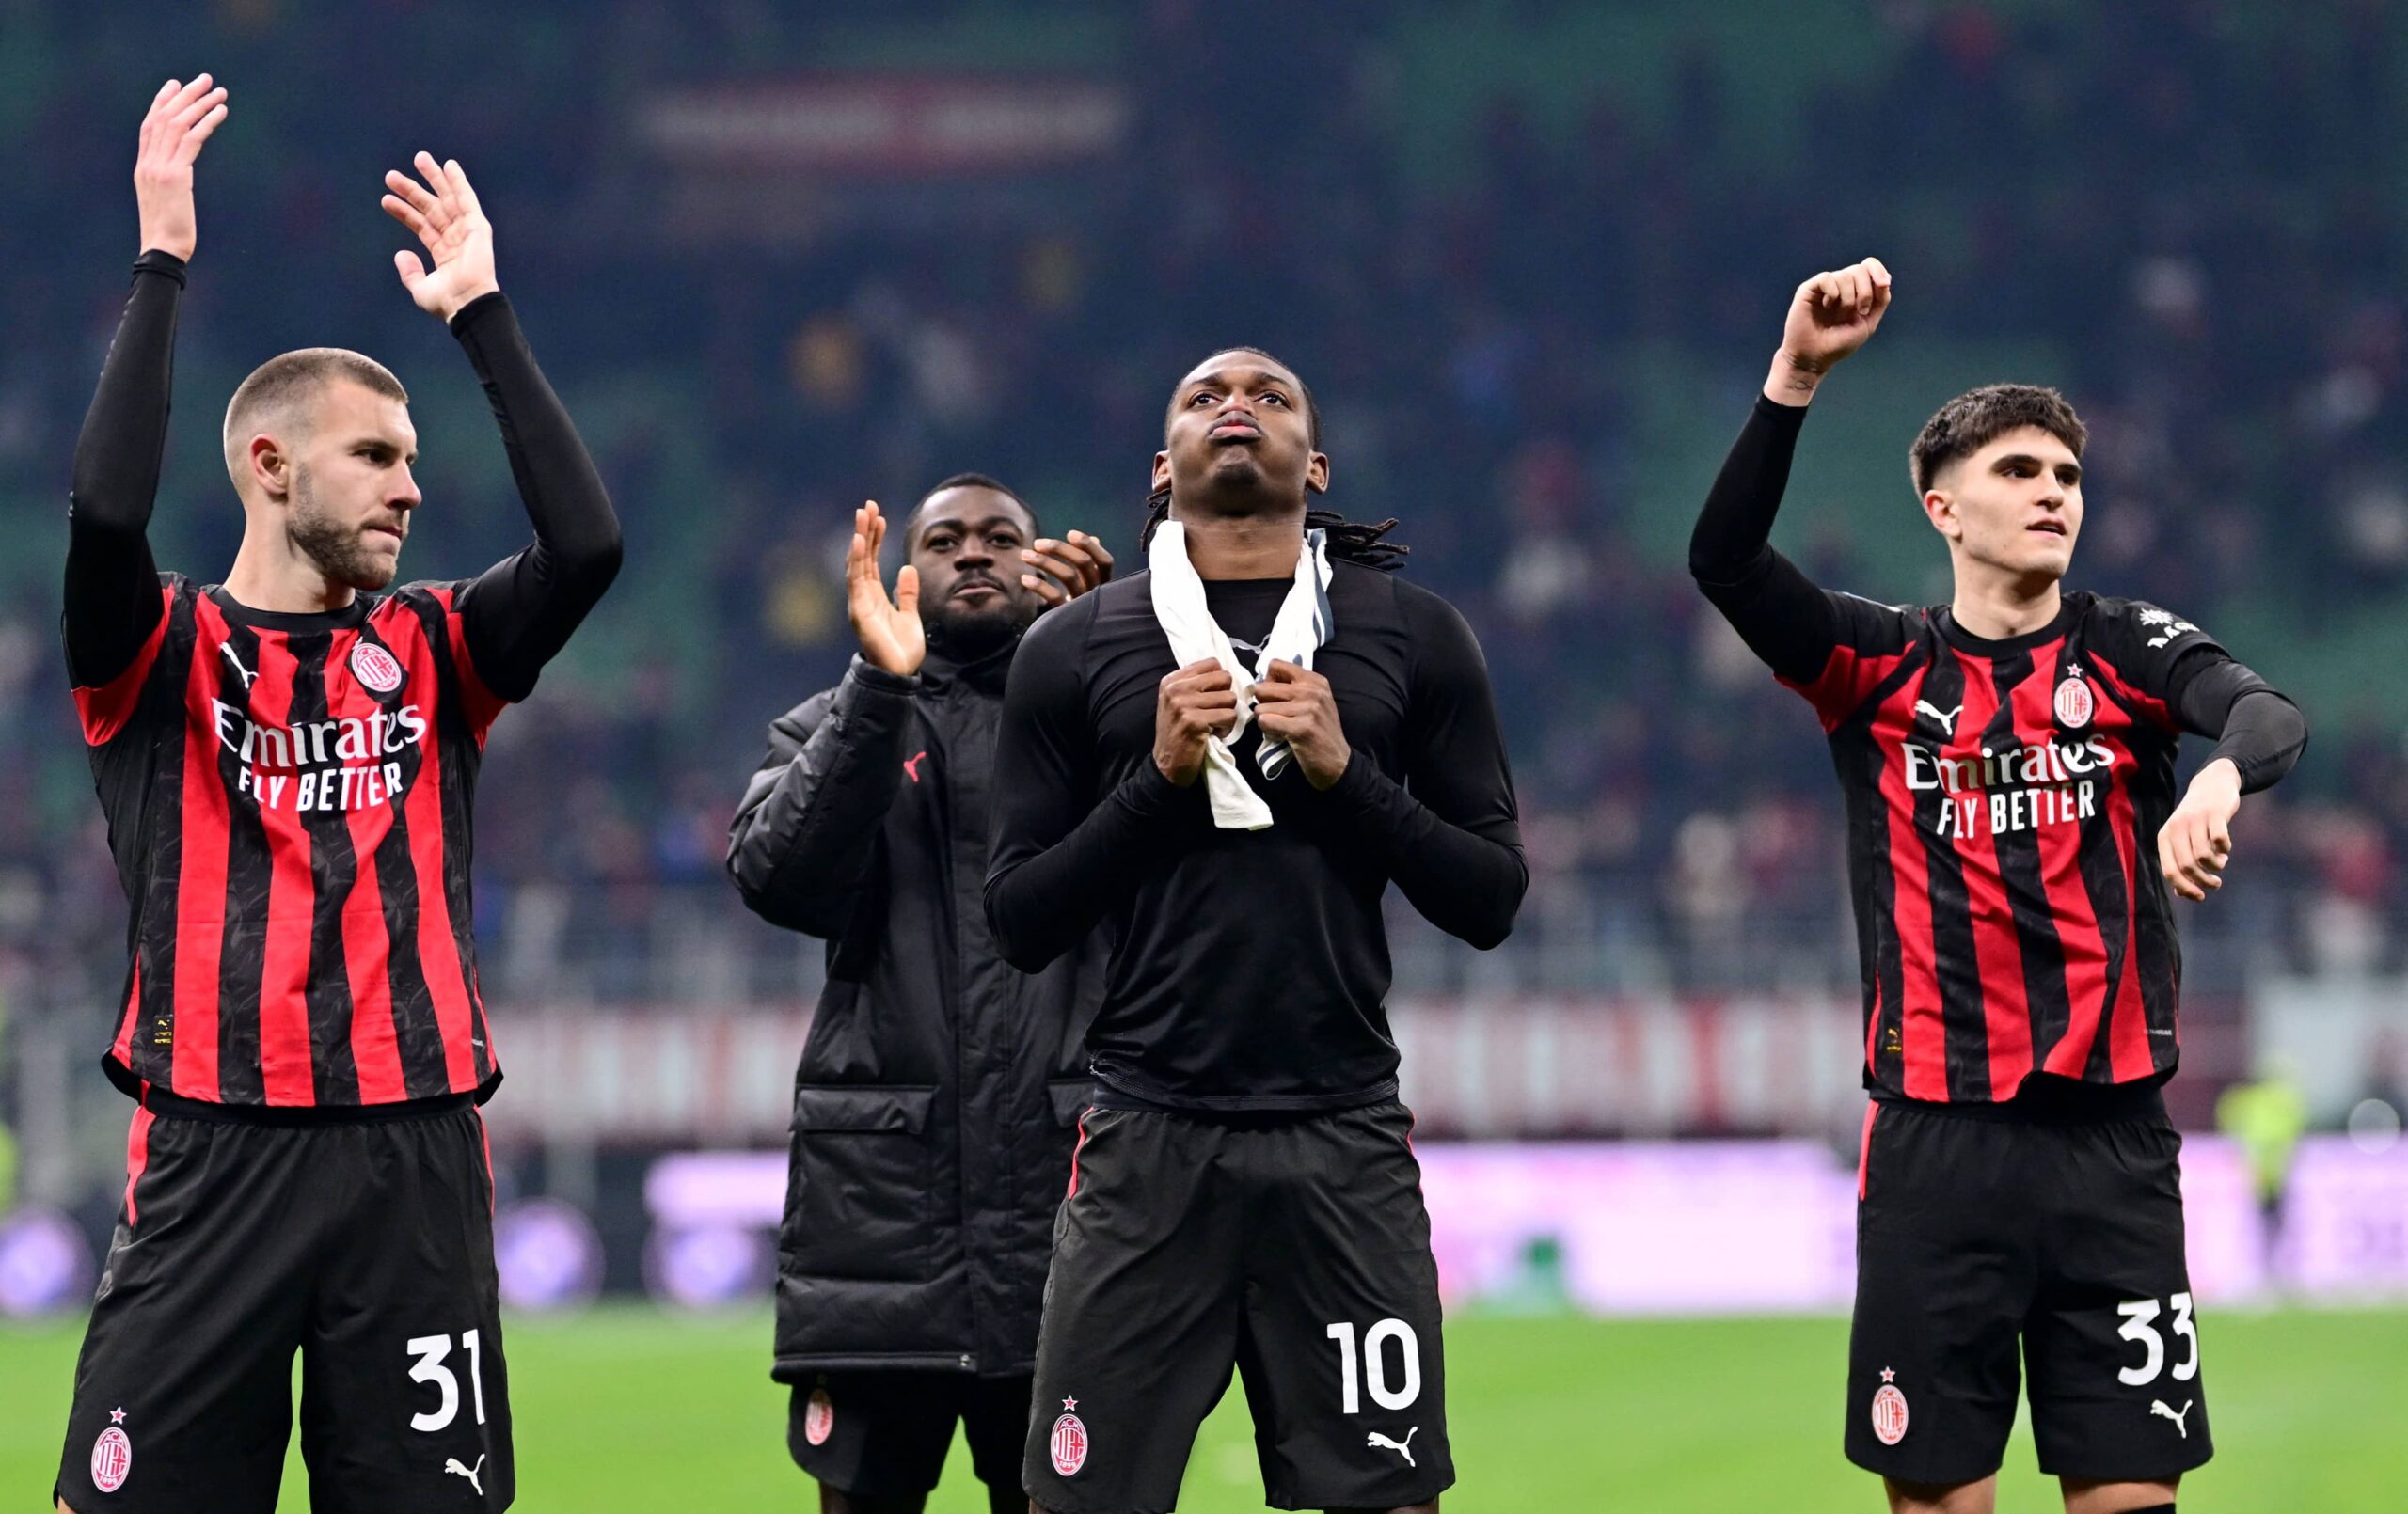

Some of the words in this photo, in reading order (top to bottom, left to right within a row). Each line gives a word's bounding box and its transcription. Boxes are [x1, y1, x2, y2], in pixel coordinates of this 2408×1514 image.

[211, 697, 427, 767] Emirates
[1900, 733, 2115, 794] Emirates
[238, 765, 287, 810] FLY
[295, 762, 404, 812] BETTER
[1936, 797, 1978, 839] FLY
[1990, 780, 2096, 835] BETTER
[1326, 1317, 1421, 1414] 10
[2117, 1291, 2198, 1386] 33
[406, 1328, 486, 1432] 31
